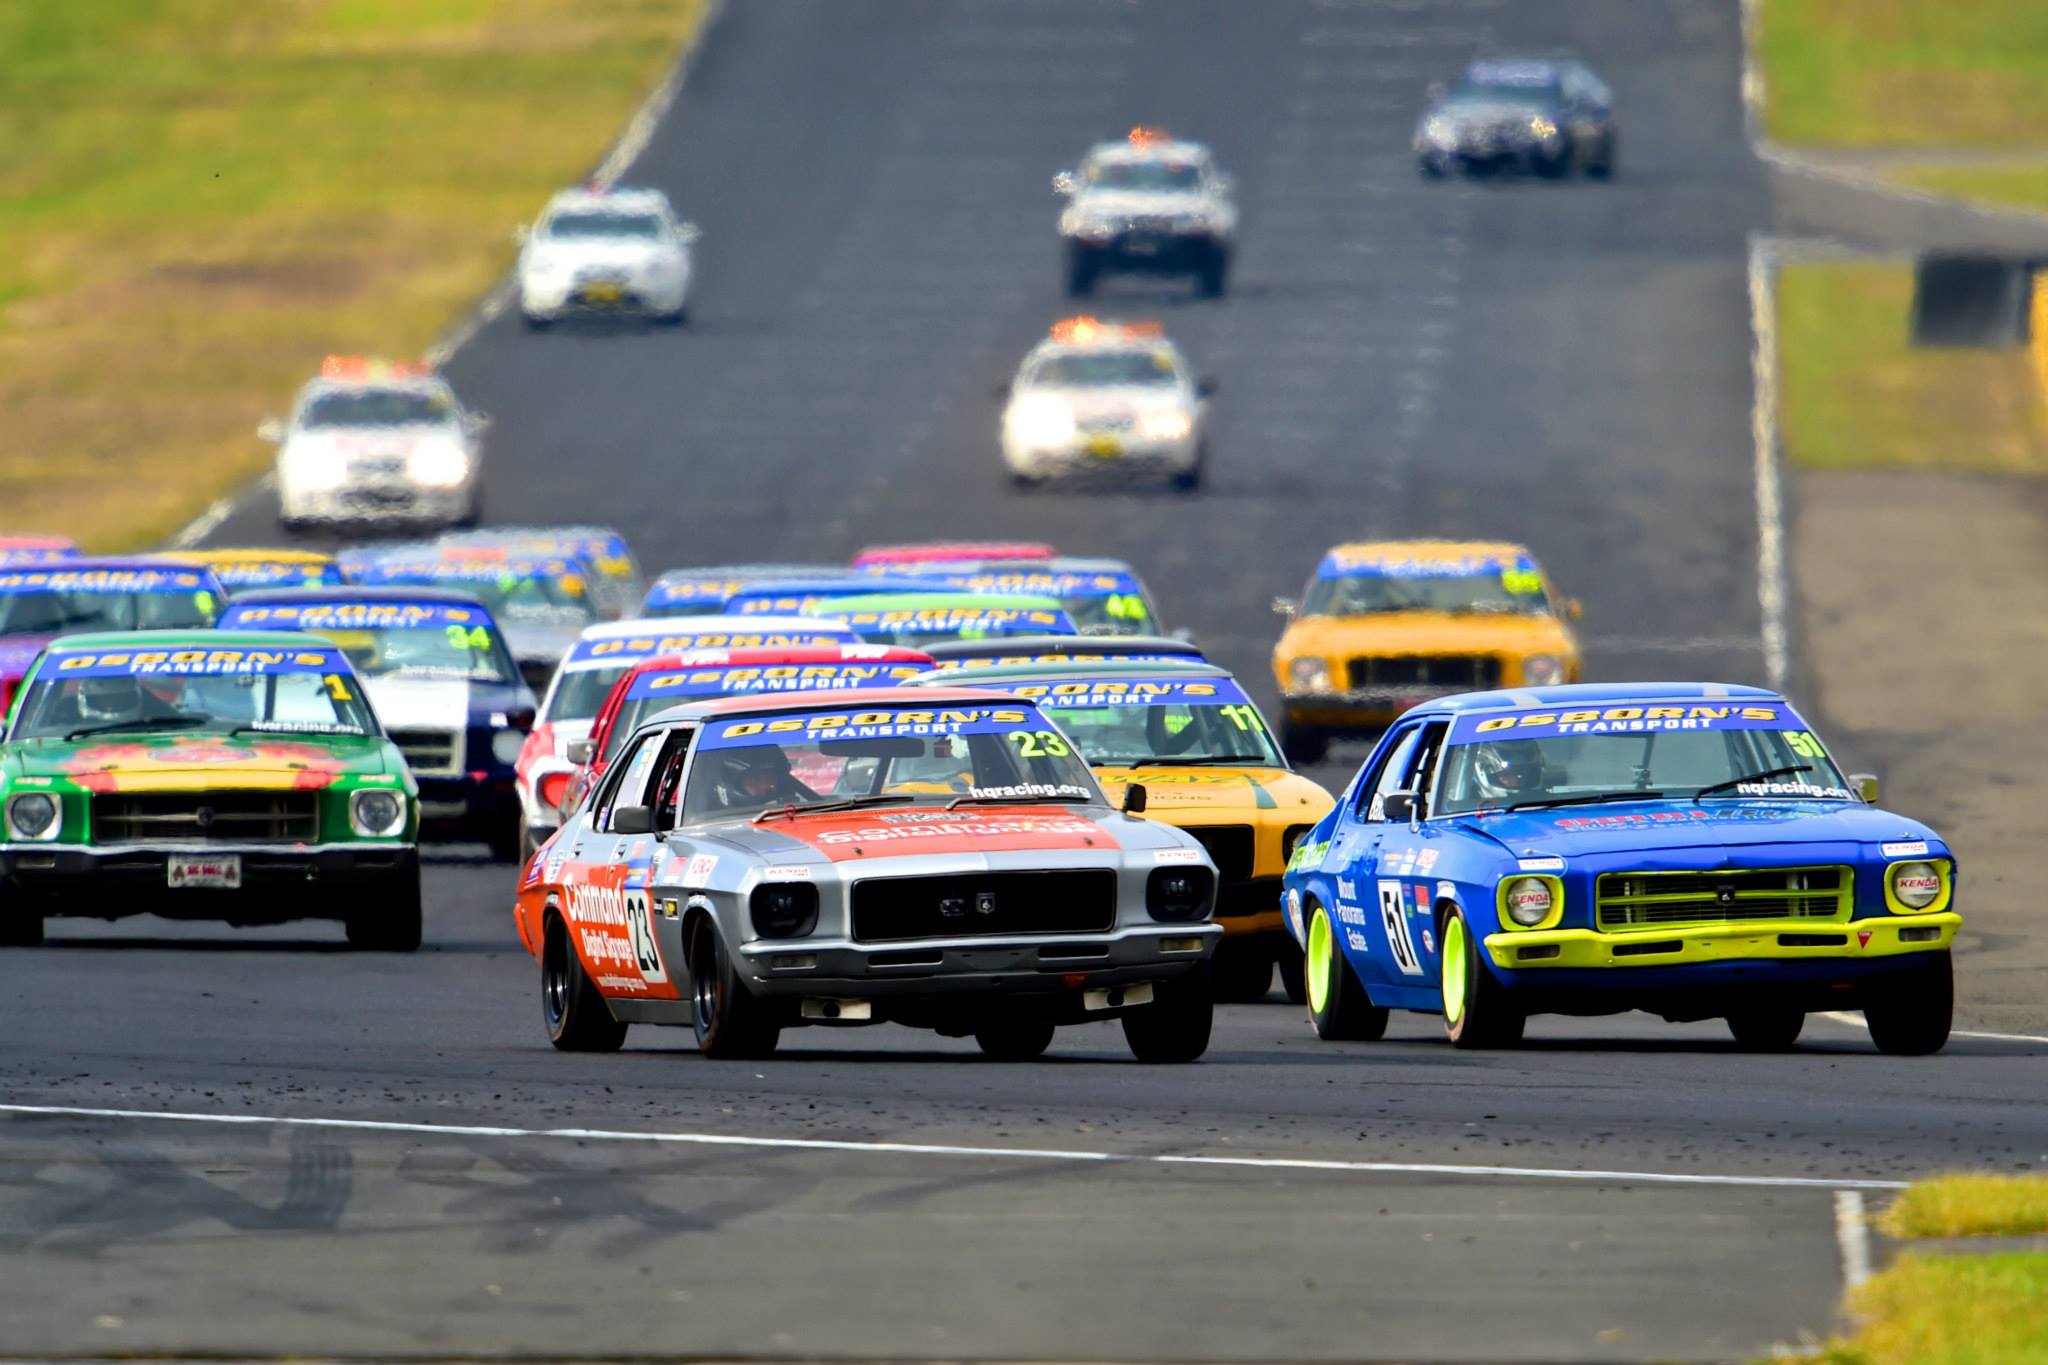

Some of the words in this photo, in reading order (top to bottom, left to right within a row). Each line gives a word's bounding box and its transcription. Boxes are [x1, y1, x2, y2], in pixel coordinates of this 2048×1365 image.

[445, 626, 492, 651] 34
[60, 651, 325, 670] OSBORN'S
[129, 662, 267, 673] TRANSPORT
[324, 674, 352, 701] 1
[650, 666, 921, 689] OSBORN'S
[721, 676, 861, 691] TRANSPORT
[1009, 683, 1217, 698] BORN'S
[1036, 694, 1155, 706] ANSPORT
[722, 709, 1030, 739] OSBORN'S
[1220, 704, 1263, 731] 11
[1476, 706, 1780, 733] OSBORN'S
[1558, 718, 1713, 733] TRANSPORT
[806, 722, 963, 739] TRANSPORT
[1009, 730, 1070, 758] 23
[1782, 730, 1825, 758] 51
[968, 782, 1091, 799] hqracing.org
[1899, 879, 1937, 888] KENDA
[564, 874, 626, 926] Command
[1513, 893, 1549, 905] ENDA
[627, 898, 659, 971] 23
[1383, 891, 1416, 967] 51
